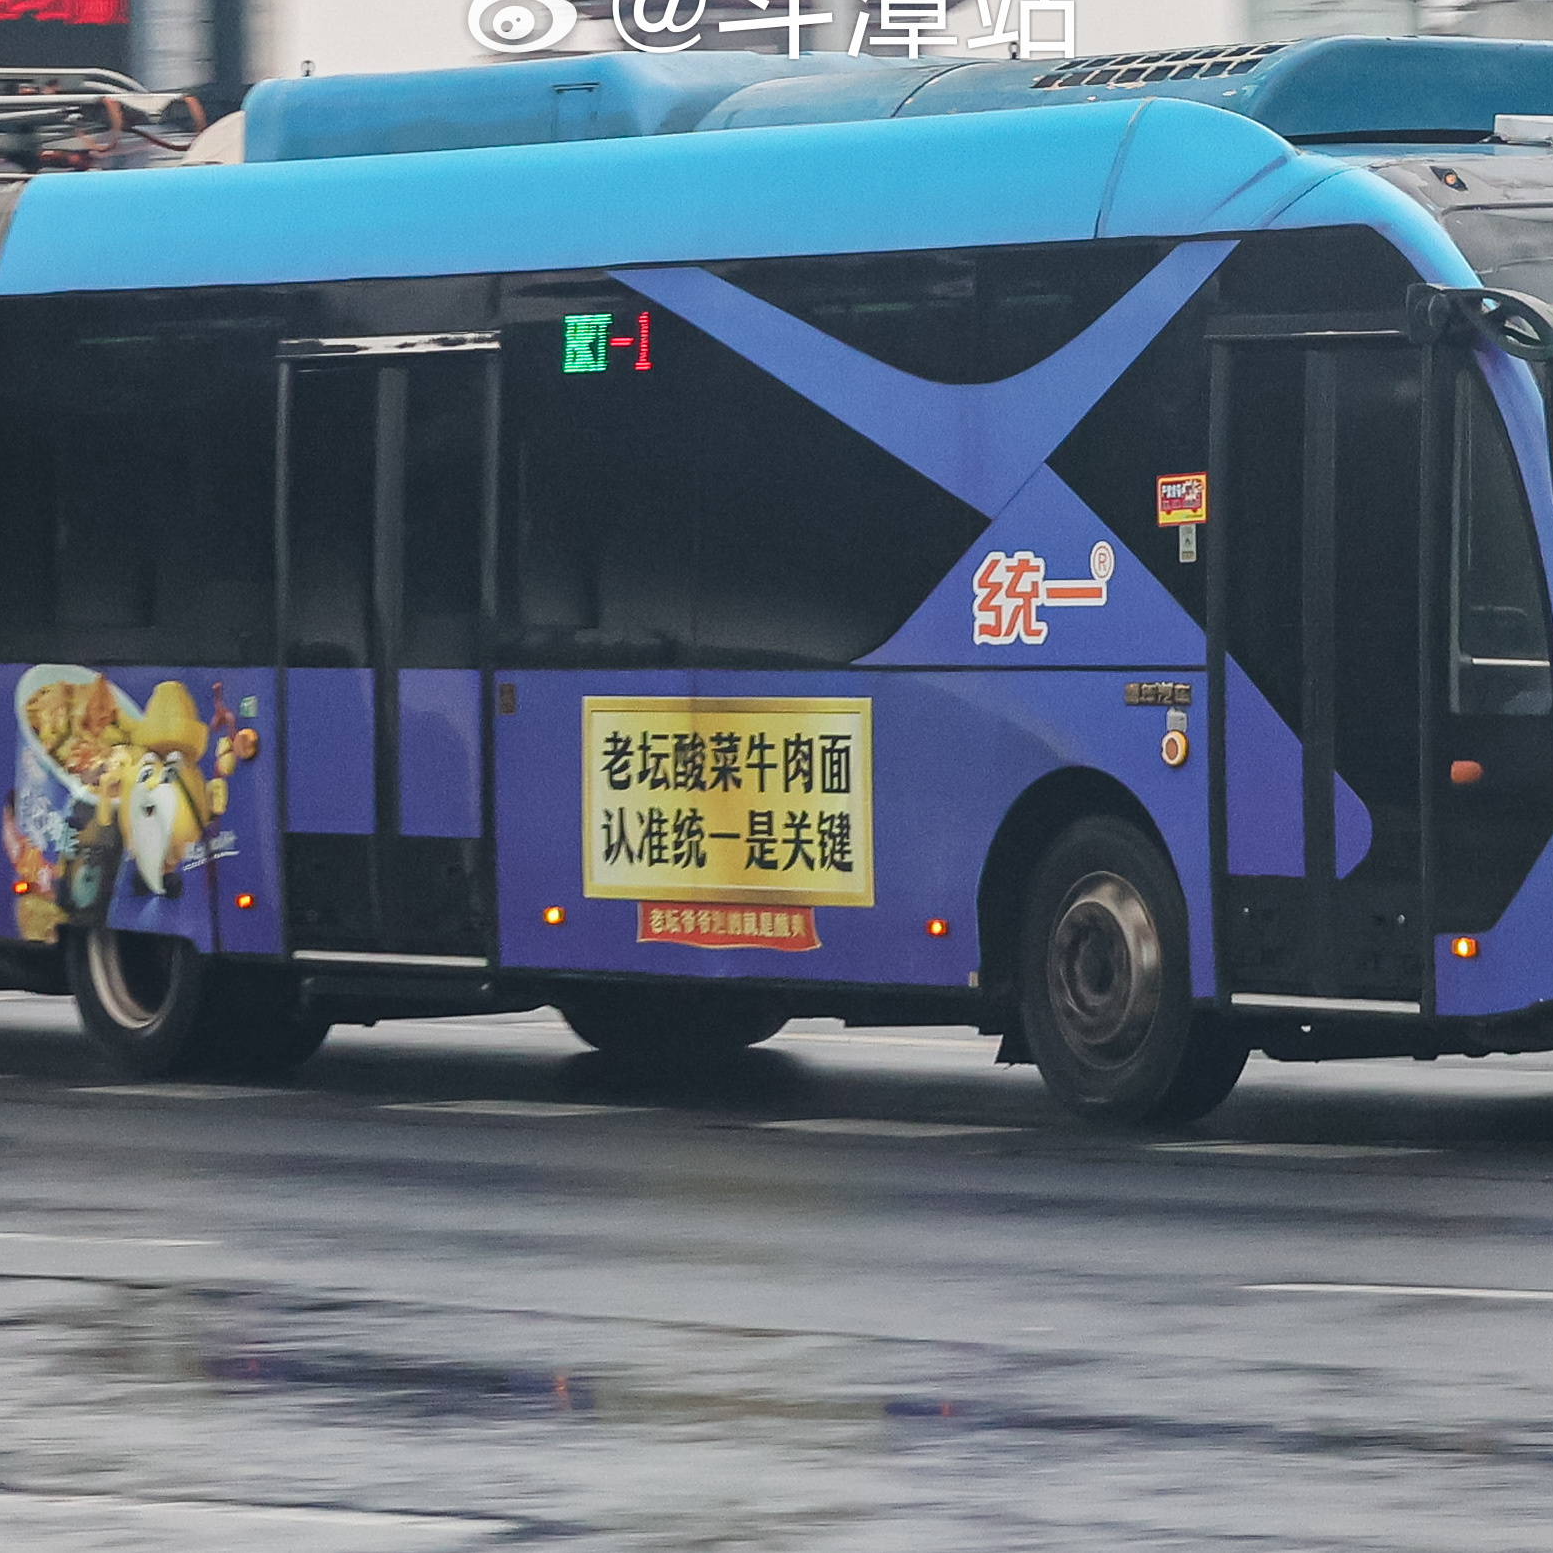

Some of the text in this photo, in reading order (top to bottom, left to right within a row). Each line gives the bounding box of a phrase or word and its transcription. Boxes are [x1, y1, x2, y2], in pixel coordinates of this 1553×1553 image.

[601, 731, 852, 794] 老坛酸菜牛肉面
[602, 807, 853, 872] 认准统一是关键
